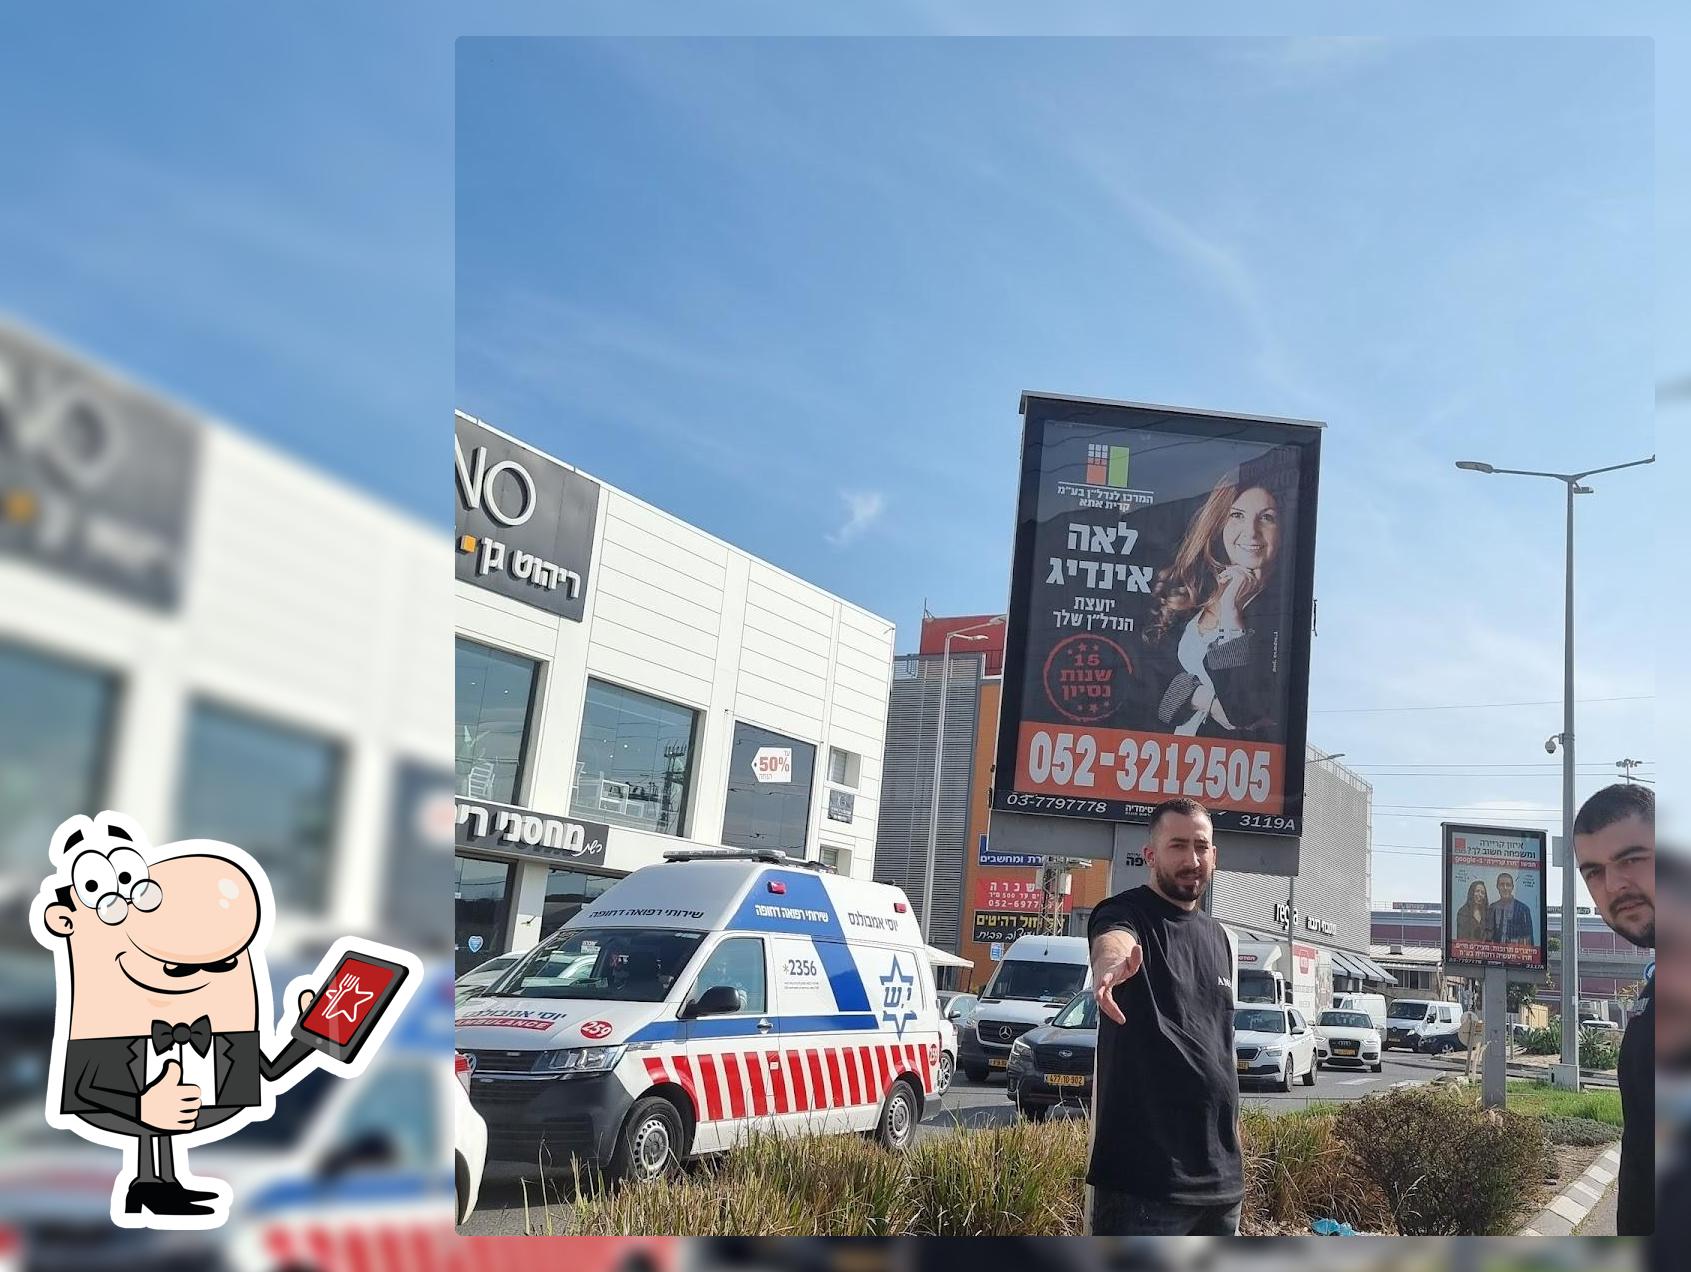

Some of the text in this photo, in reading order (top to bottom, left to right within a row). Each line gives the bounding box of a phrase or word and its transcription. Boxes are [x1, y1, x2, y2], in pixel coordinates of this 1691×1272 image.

[1079, 498, 1130, 512] קרית אתא
[1067, 521, 1139, 555] לאה
[479, 536, 581, 599] ריהוט גן
[1046, 557, 1154, 593] אינדיג
[1073, 596, 1116, 612] יועצת
[1053, 609, 1084, 628] שלך
[1060, 668, 1113, 682] שנות
[1062, 684, 1112, 701] נסיון
[759, 756, 790, 773] 50%
[1028, 731, 1271, 804] 052-3212505
[1006, 794, 1107, 814] 03-7797778
[455, 804, 489, 837] רי
[1240, 814, 1296, 831] 3119A
[495, 811, 586, 852] מחסני
[980, 855, 1024, 863] ומחשבים
[988, 899, 1041, 908] 052-6977
[589, 908, 705, 919] שירותי רפואה דחופה
[847, 910, 898, 932] יוסי אמבולנס
[1276, 903, 1299, 930] rega
[537, 1011, 567, 1020] יוסי
[582, 1021, 611, 1037] 259
